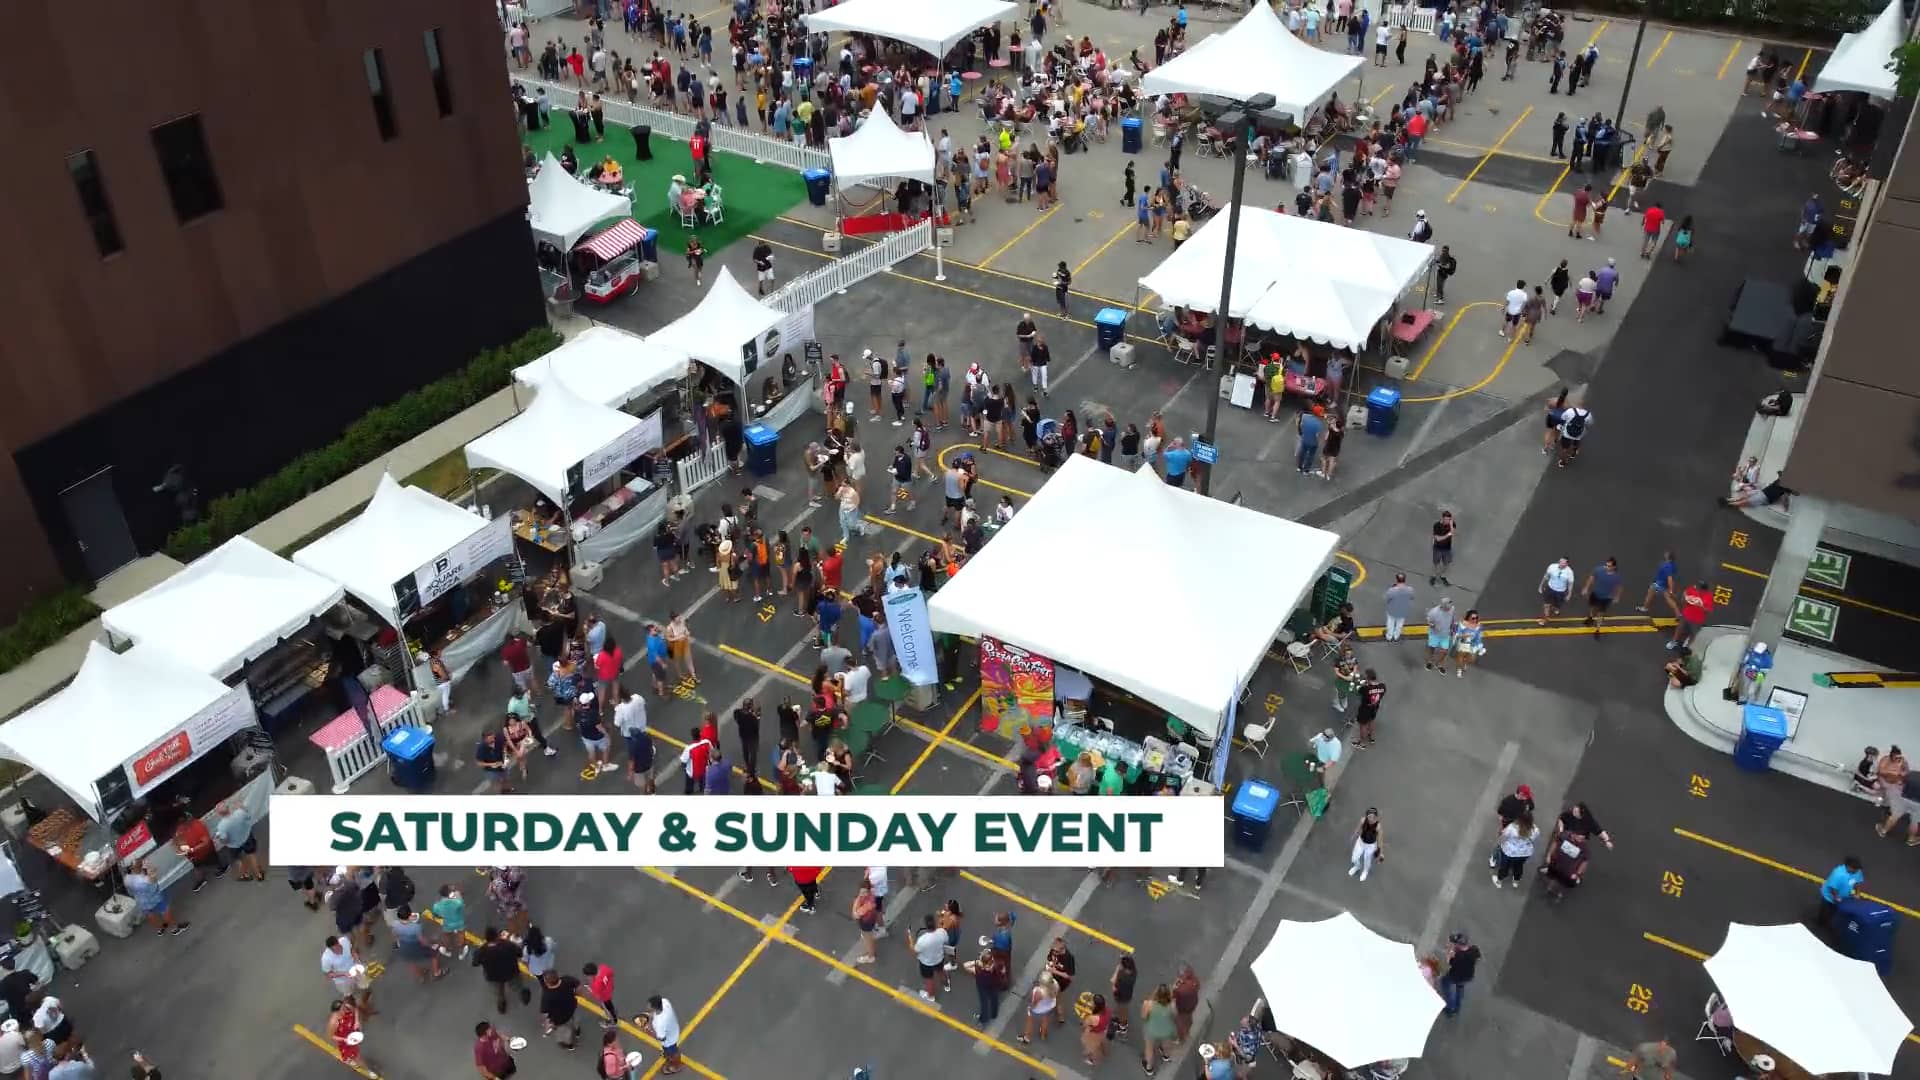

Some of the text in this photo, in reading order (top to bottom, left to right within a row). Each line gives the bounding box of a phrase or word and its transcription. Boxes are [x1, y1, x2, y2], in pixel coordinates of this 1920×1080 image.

[1793, 599, 1833, 637] EV
[897, 607, 920, 672] Welcome
[1689, 774, 1712, 799] 24
[1661, 869, 1685, 898] 25
[1626, 983, 1654, 1015] 26
